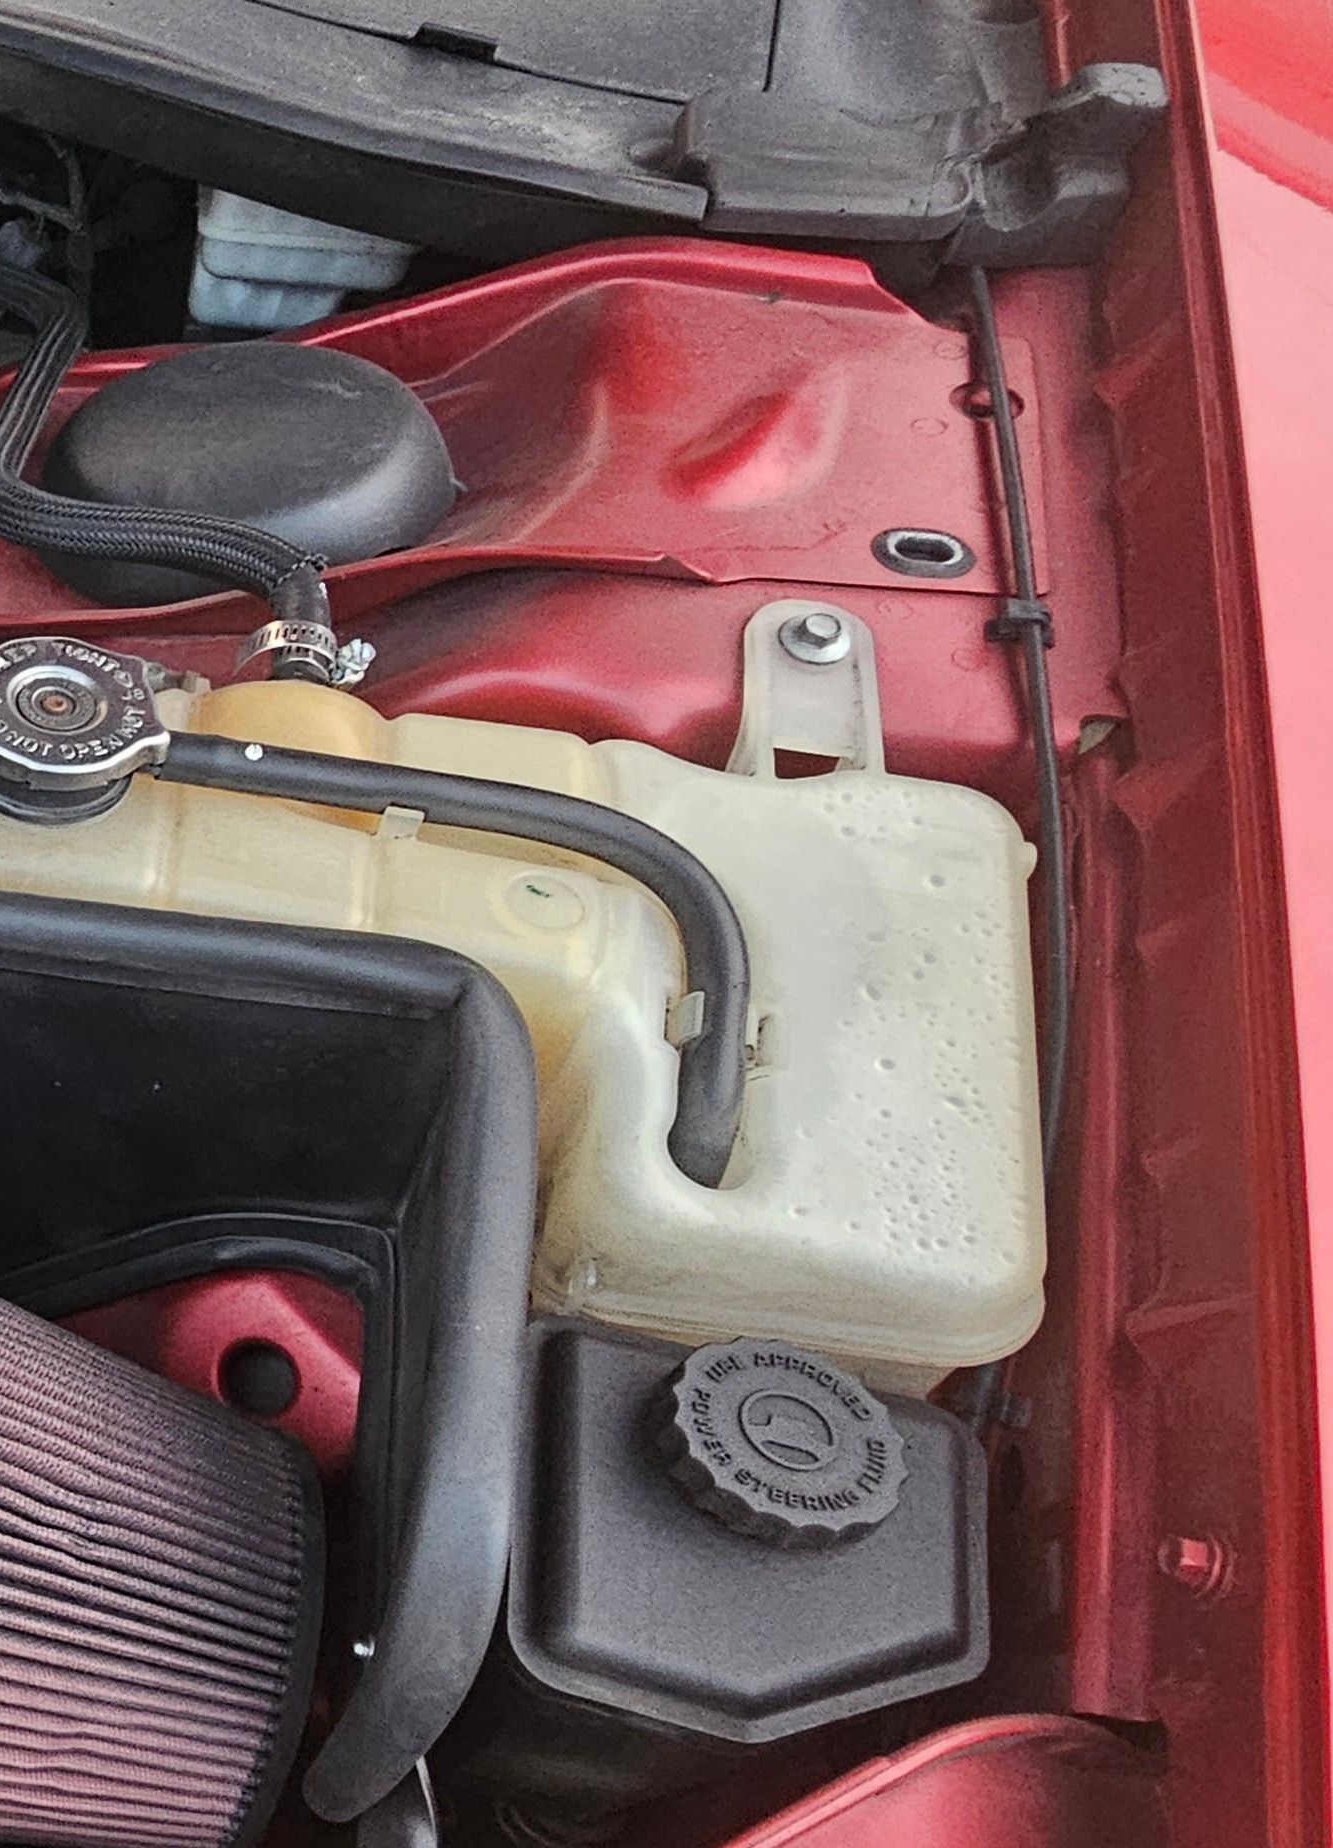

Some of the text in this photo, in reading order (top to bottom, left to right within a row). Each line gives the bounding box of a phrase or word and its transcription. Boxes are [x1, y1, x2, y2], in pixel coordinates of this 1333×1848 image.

[4, 731, 54, 757] NOT
[58, 738, 124, 761] OPEN
[118, 705, 146, 740] HOT
[752, 1351, 872, 1423] APPROVED
[690, 1387, 888, 1513] POWER STEERING FLUID
